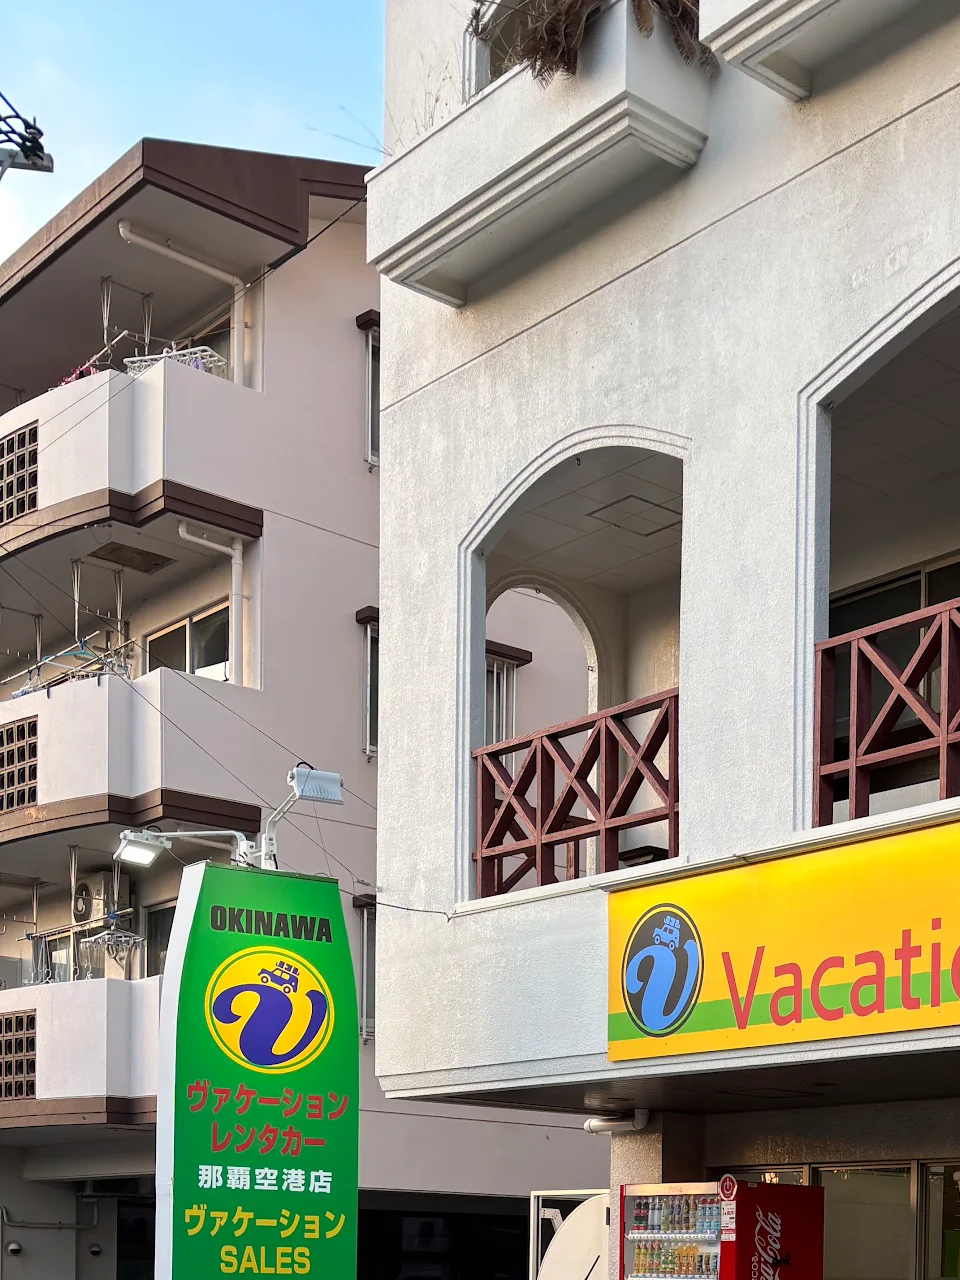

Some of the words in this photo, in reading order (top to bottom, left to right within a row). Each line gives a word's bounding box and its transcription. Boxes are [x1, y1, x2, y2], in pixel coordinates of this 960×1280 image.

[209, 904, 333, 944] OKINAWA
[186, 1079, 349, 1121] ヴァケーション
[211, 1121, 326, 1157] レンタカー
[198, 1164, 332, 1194] 那覇空港店
[183, 1204, 346, 1240] ヴァケーション
[219, 1246, 311, 1275] SALES
